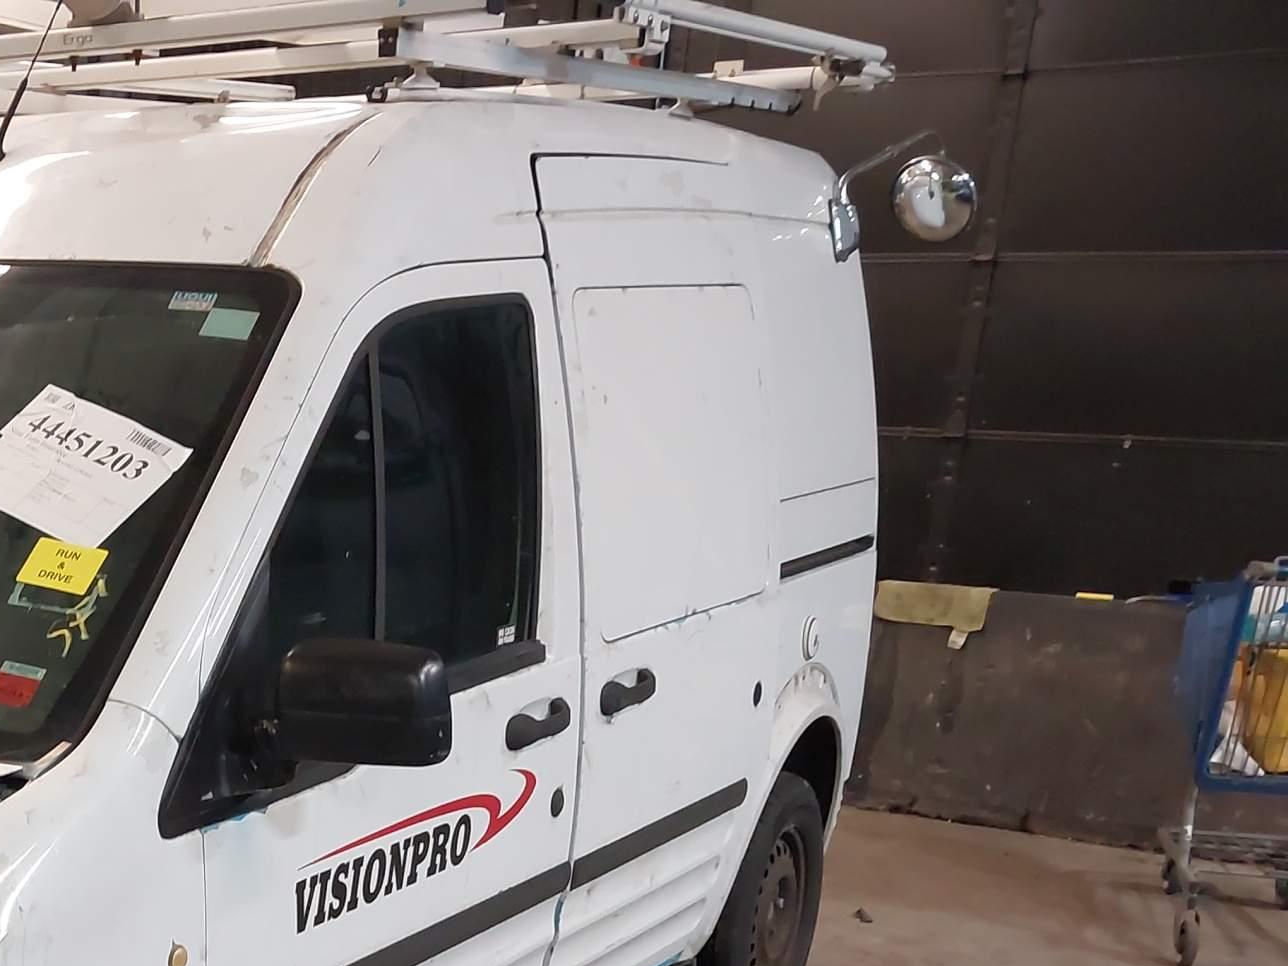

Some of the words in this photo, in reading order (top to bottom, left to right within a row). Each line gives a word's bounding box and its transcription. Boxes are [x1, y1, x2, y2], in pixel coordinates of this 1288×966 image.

[28, 415, 150, 481] 44451203
[56, 548, 82, 561] RUN
[57, 561, 65, 570] &
[37, 569, 74, 584] DRIVE
[295, 814, 472, 935] VISIONPRO
